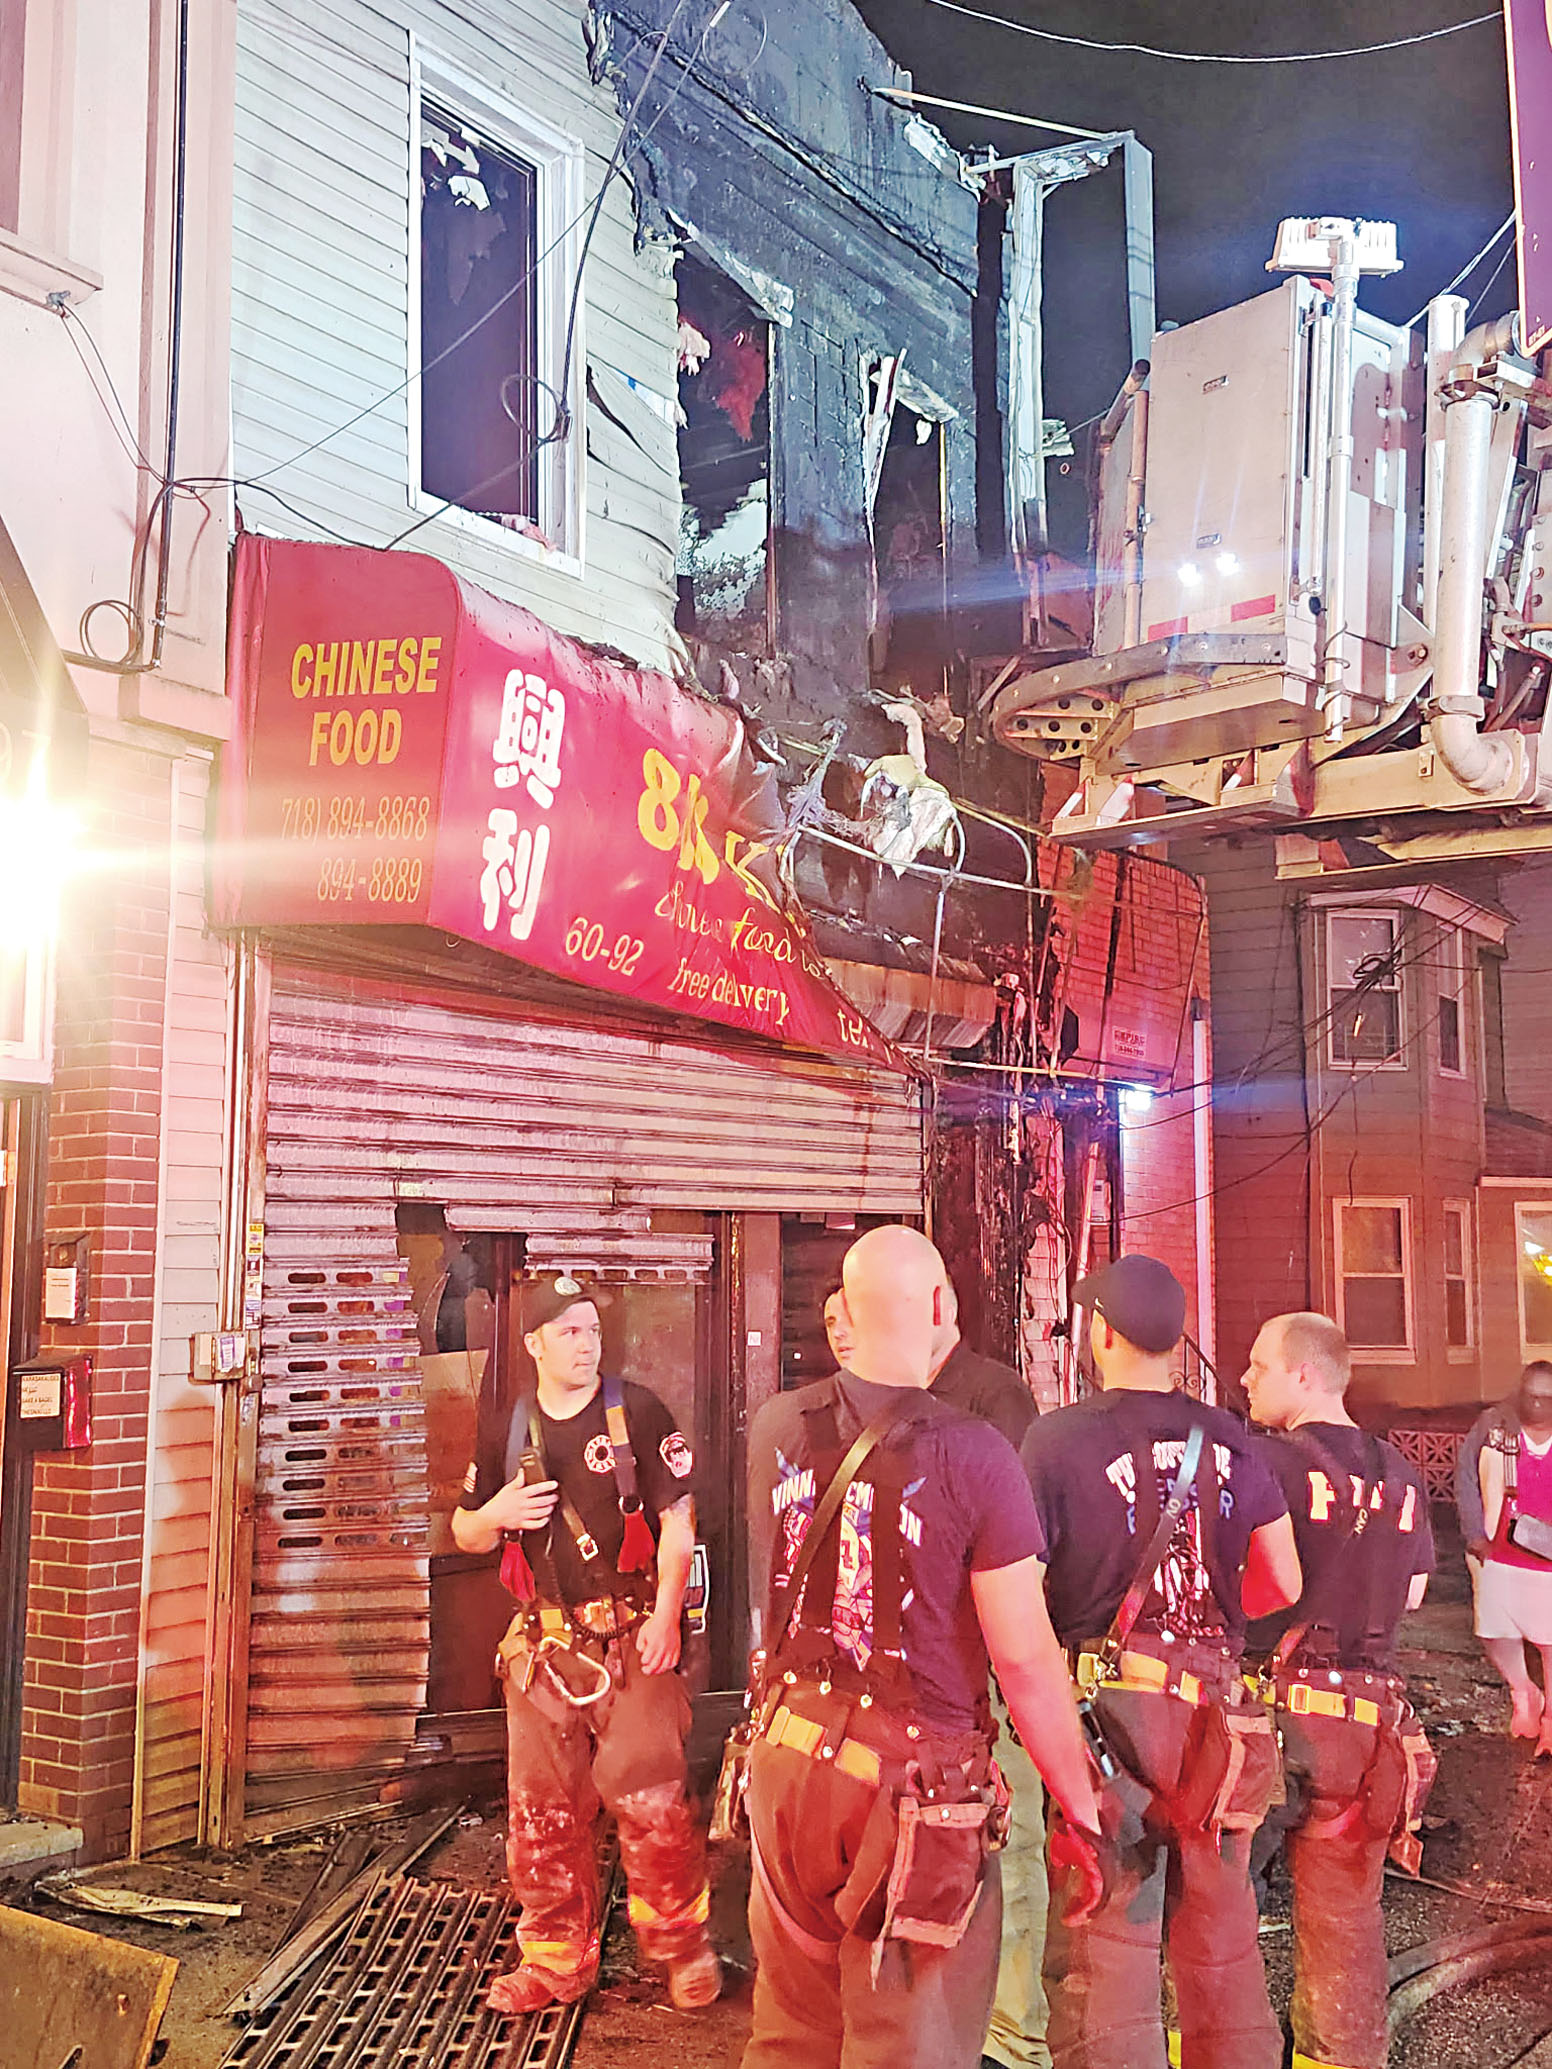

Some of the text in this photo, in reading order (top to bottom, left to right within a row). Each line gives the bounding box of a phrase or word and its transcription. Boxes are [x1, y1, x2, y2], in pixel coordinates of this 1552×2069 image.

[290, 636, 442, 699] CHINESE
[308, 708, 403, 767] FOOD
[326, 795, 431, 842] 894-8868
[317, 856, 423, 904] 894-8889
[564, 917, 645, 978] 60-92
[667, 957, 710, 997] free
